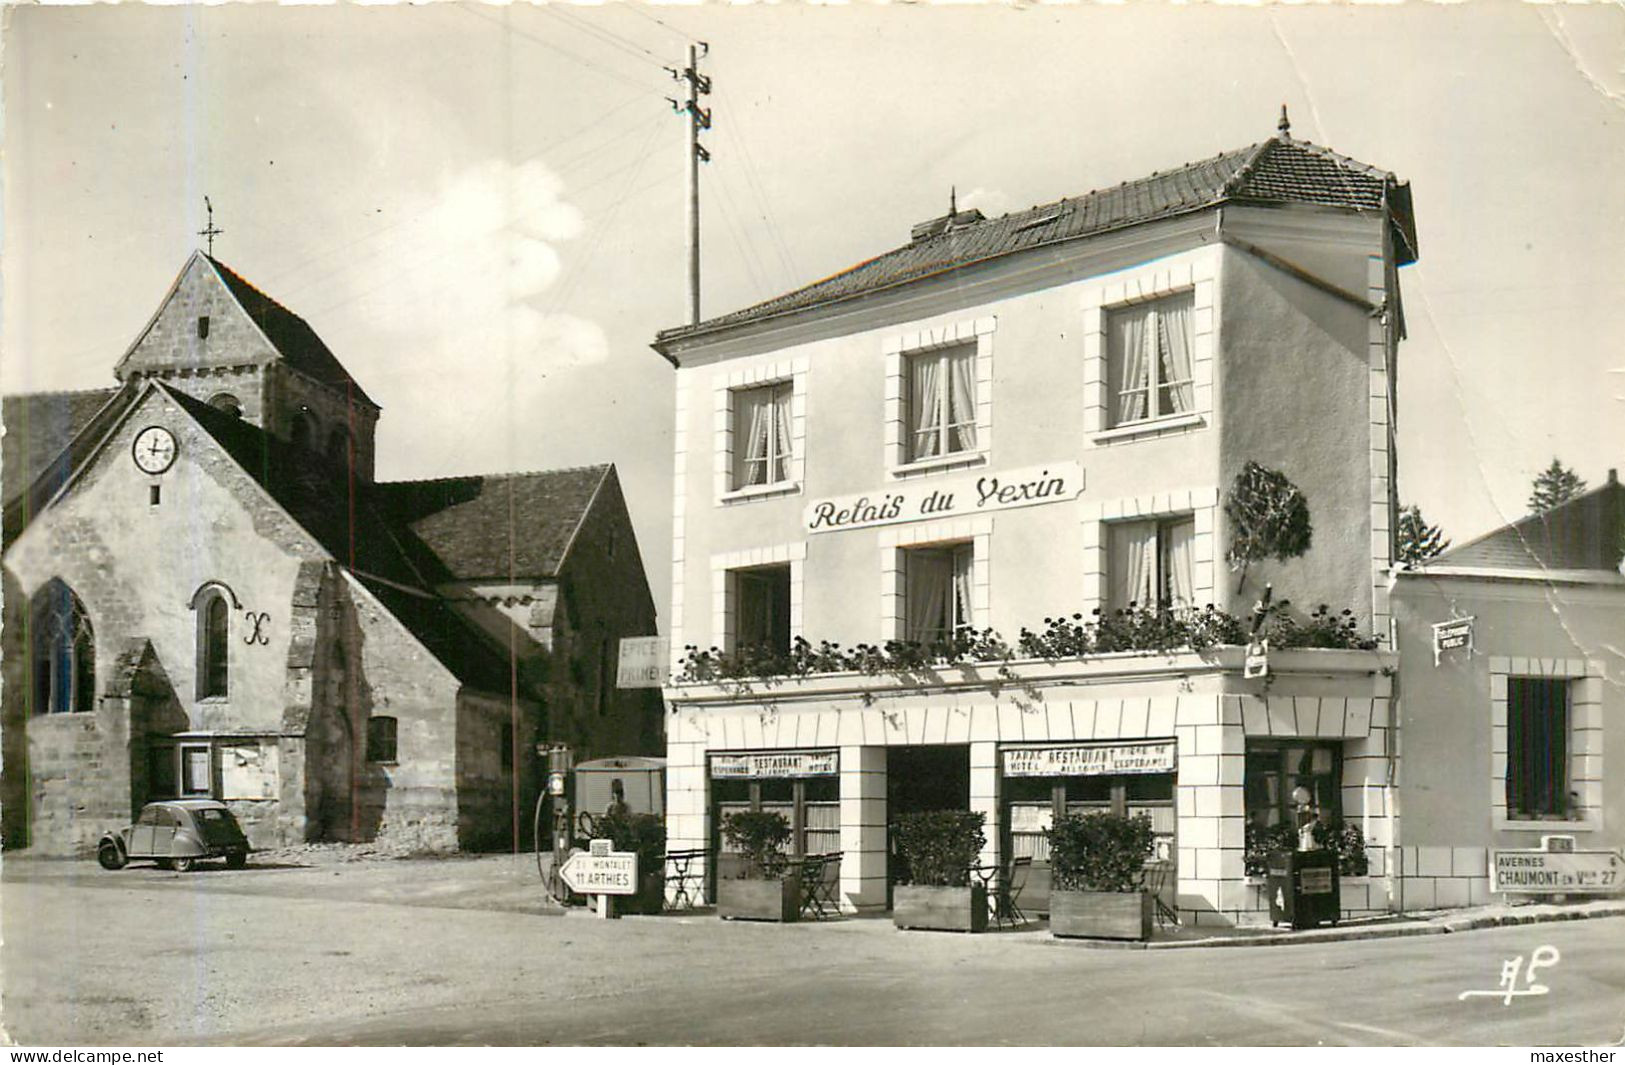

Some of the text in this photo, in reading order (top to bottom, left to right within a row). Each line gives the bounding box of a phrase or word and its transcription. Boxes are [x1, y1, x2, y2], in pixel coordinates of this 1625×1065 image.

[809, 470, 1066, 529] Relais du Vexin
[1049, 750, 1115, 764] RESTAURANT
[1498, 857, 1545, 868] AVERNES
[588, 873, 629, 886] ARTHIES
[1498, 871, 1559, 885] CHAUMONT
[1601, 871, 1617, 885] 27
